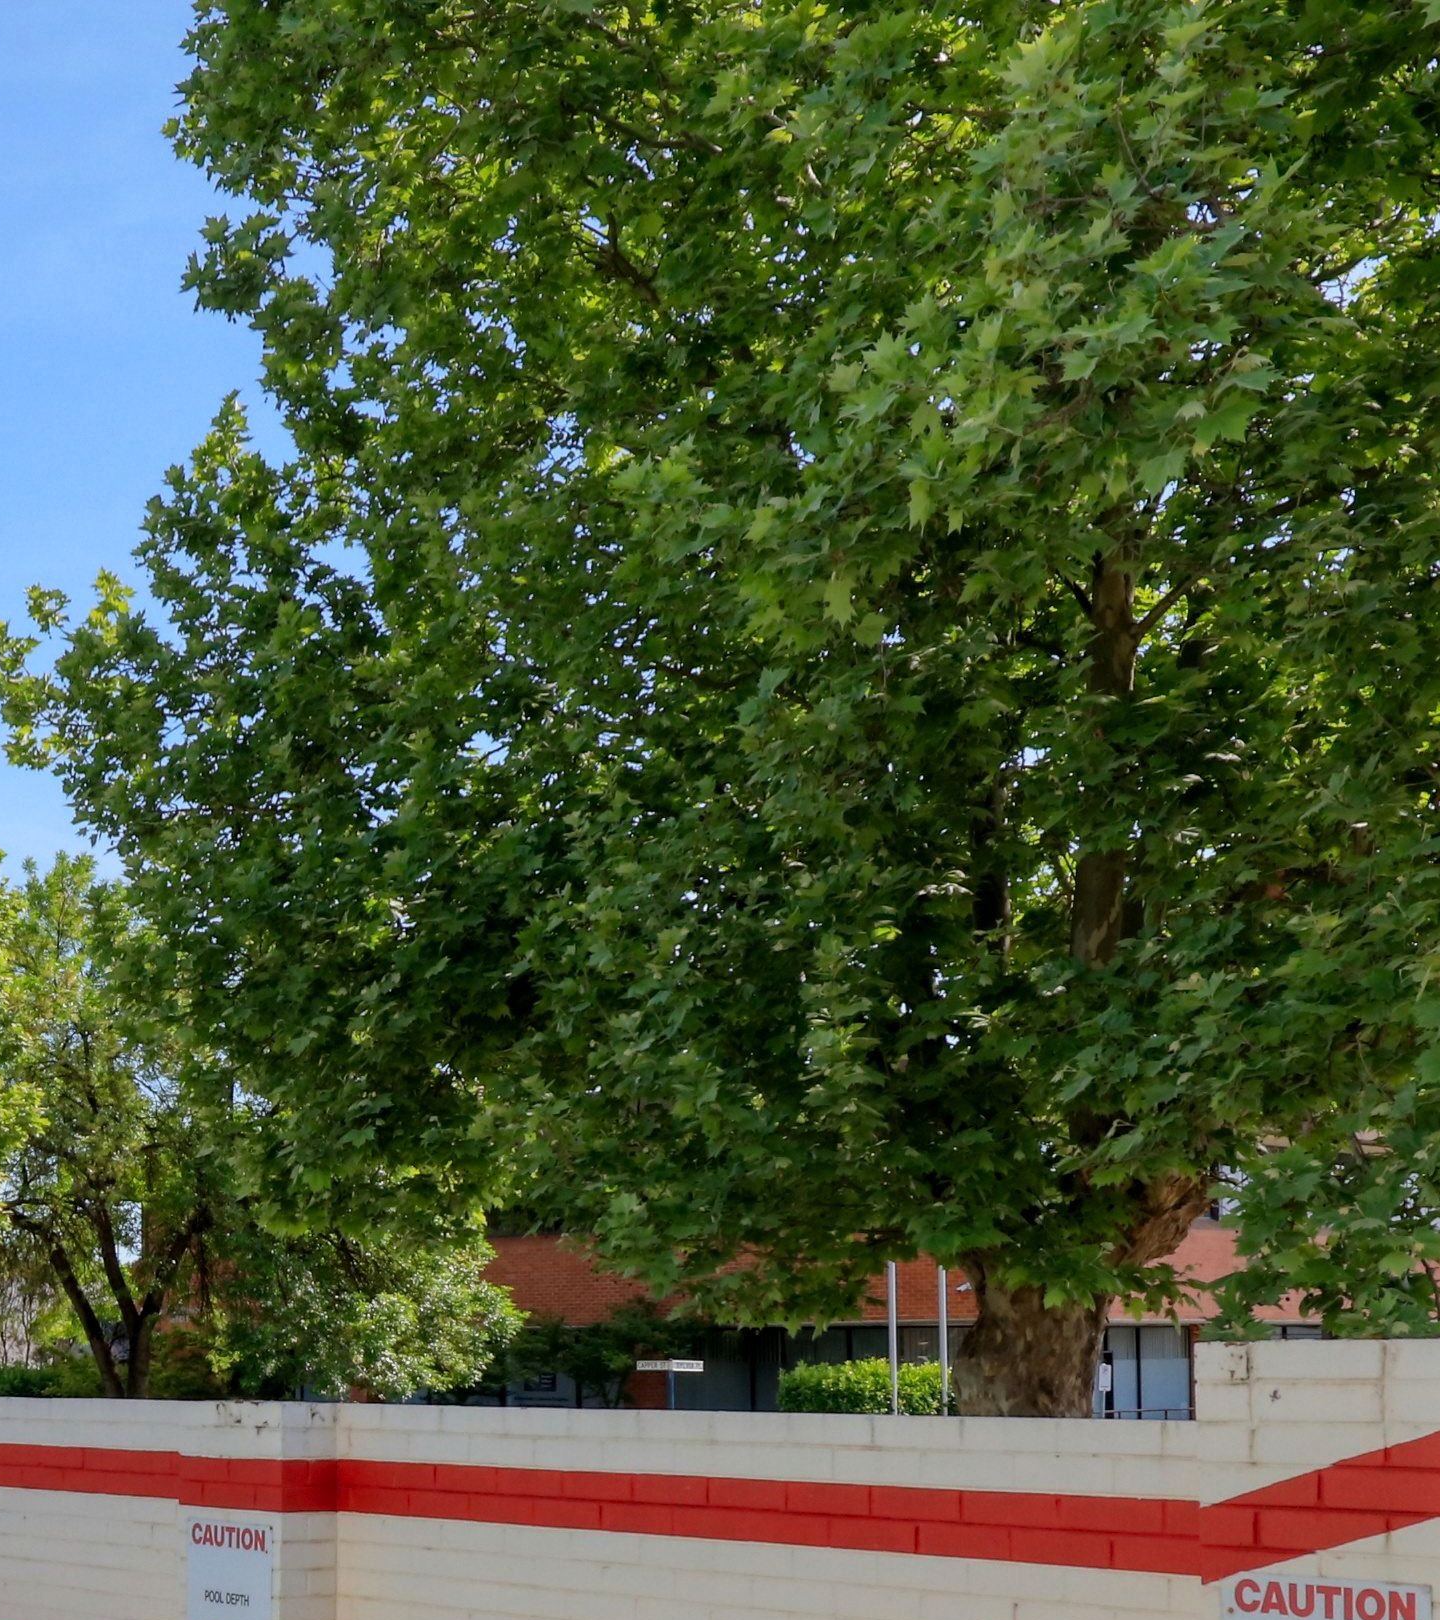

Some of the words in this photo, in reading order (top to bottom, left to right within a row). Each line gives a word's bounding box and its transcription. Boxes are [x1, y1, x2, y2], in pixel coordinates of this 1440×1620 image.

[192, 1522, 266, 1552] CAUTION
[204, 1590, 224, 1604] POOL
[226, 1592, 250, 1607] DEPTH
